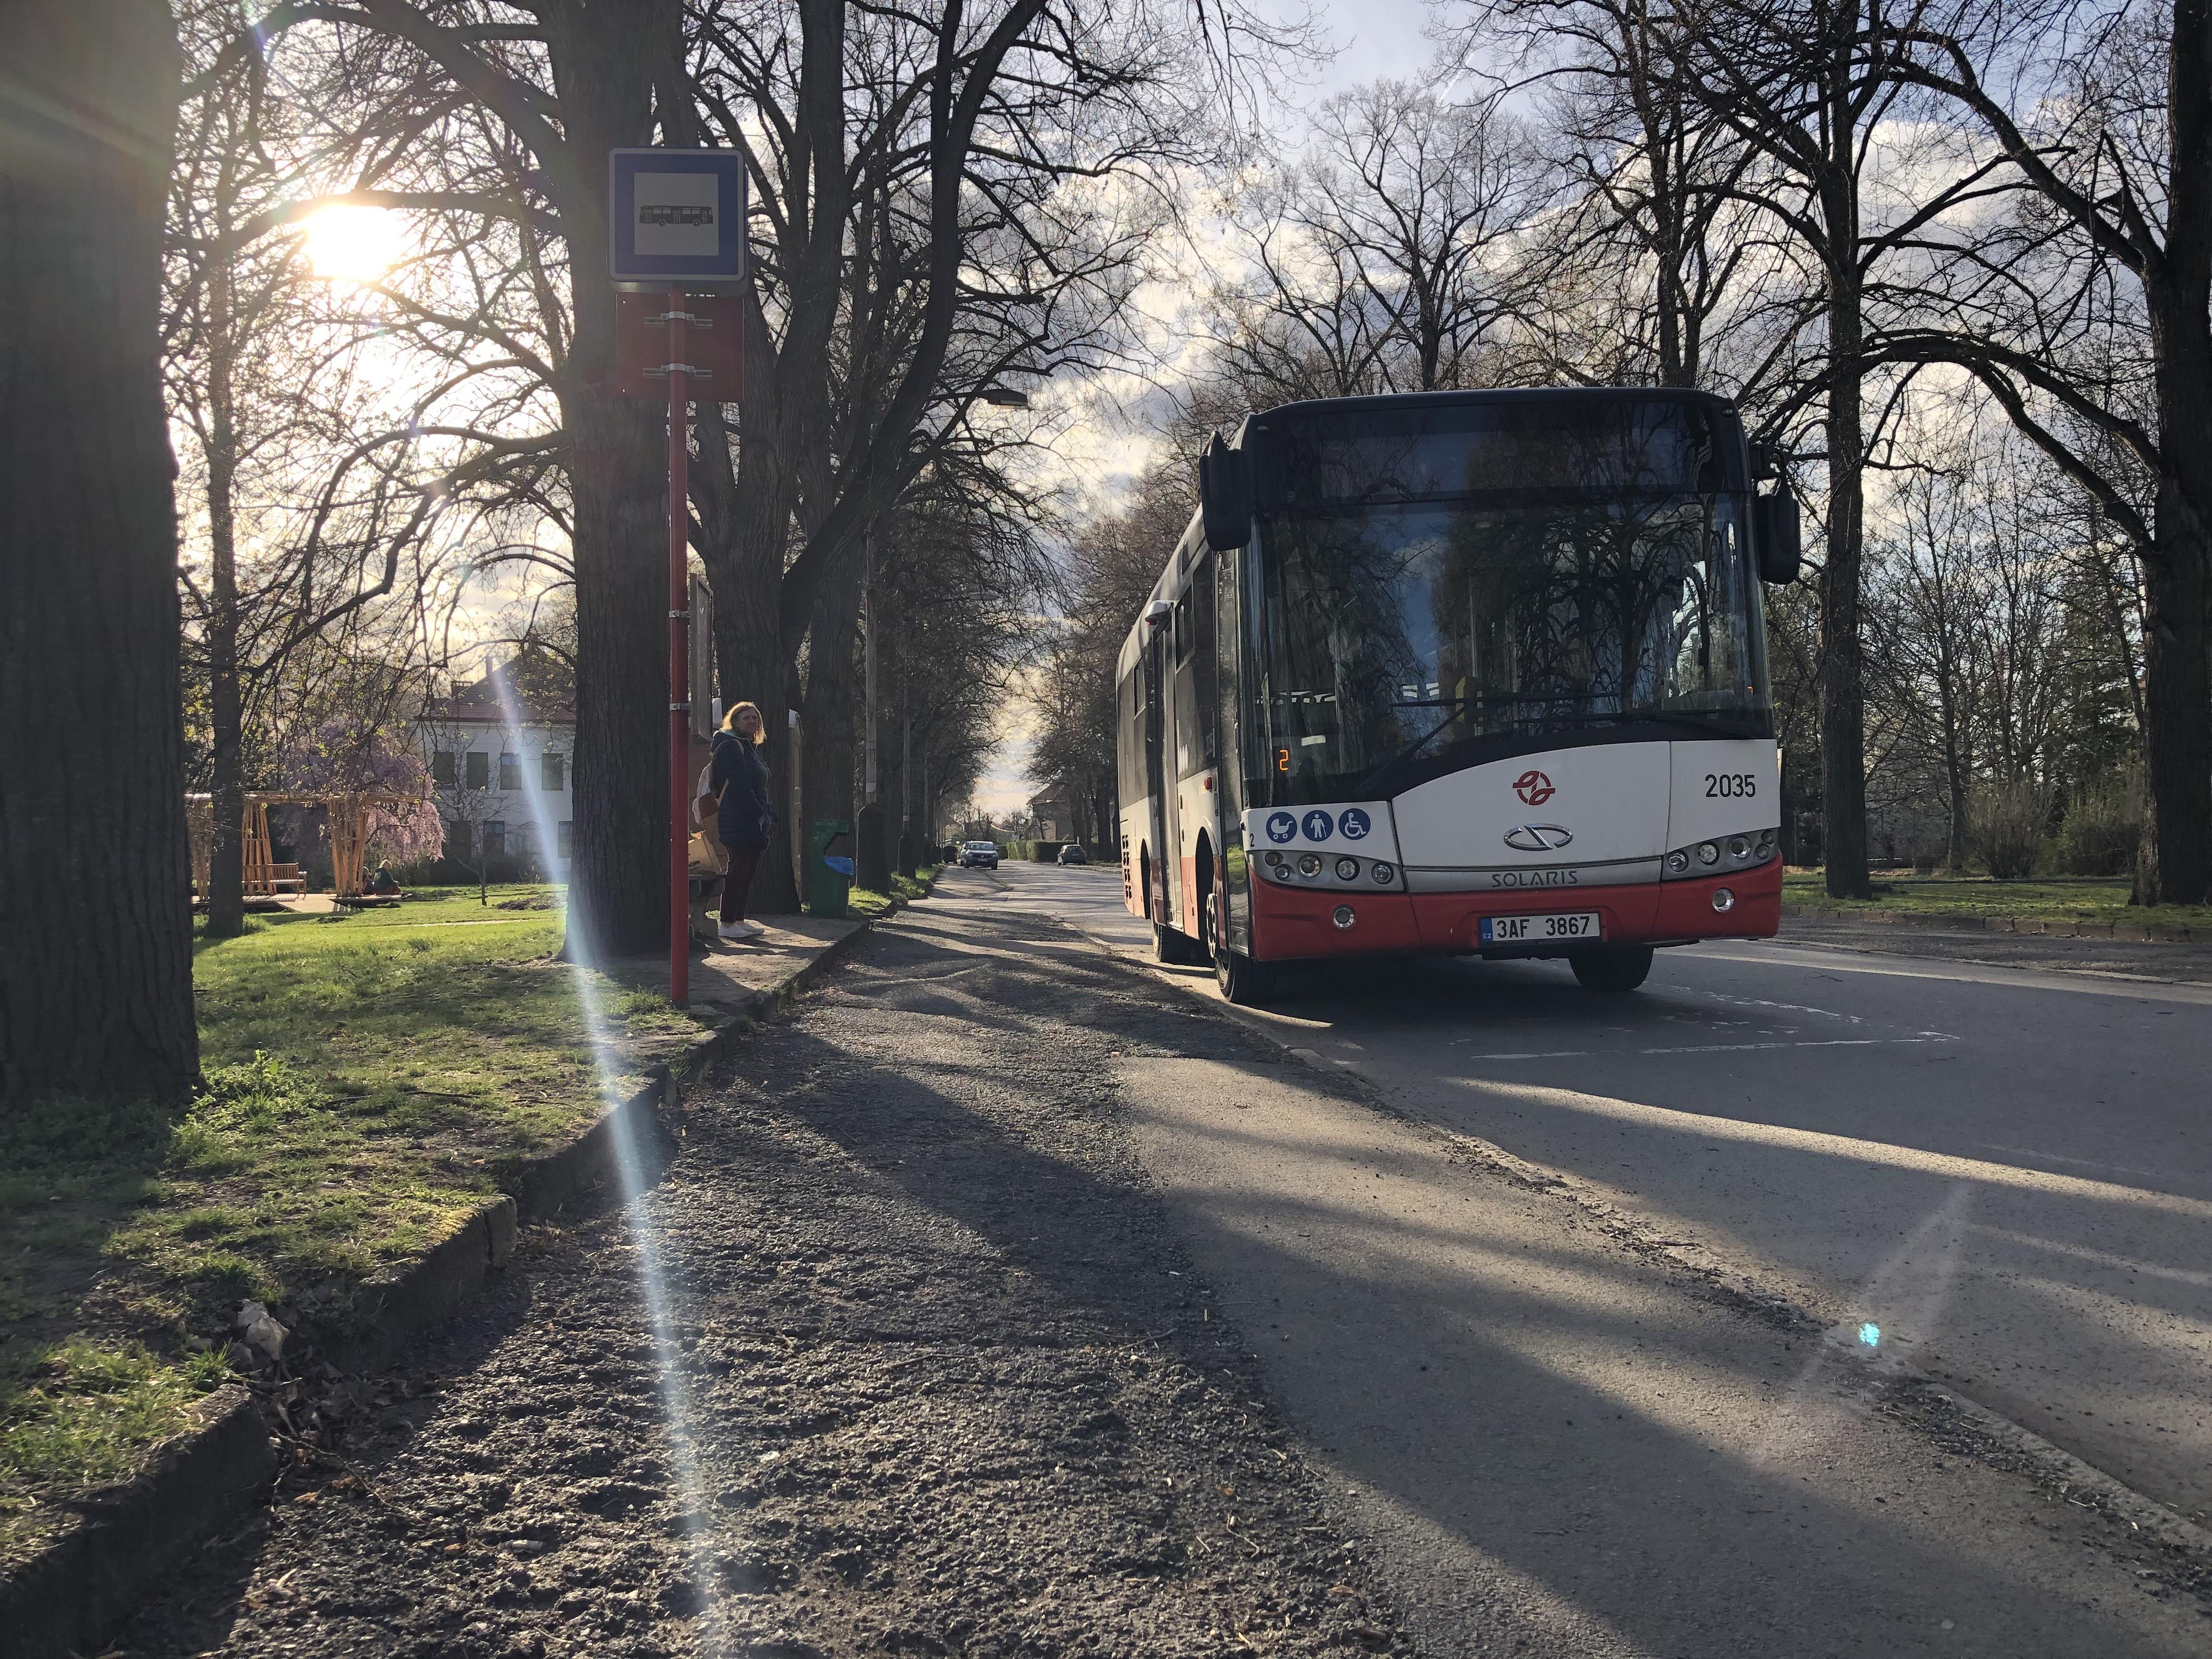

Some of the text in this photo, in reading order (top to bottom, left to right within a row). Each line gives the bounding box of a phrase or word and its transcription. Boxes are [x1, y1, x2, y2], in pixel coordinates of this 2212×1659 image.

[1280, 749, 1289, 771] 2
[1705, 774, 1756, 797] 2035
[1249, 833, 1255, 847] 2
[1491, 870, 1578, 888] SOLARIS
[1496, 916, 1590, 938] 3AF 3867
